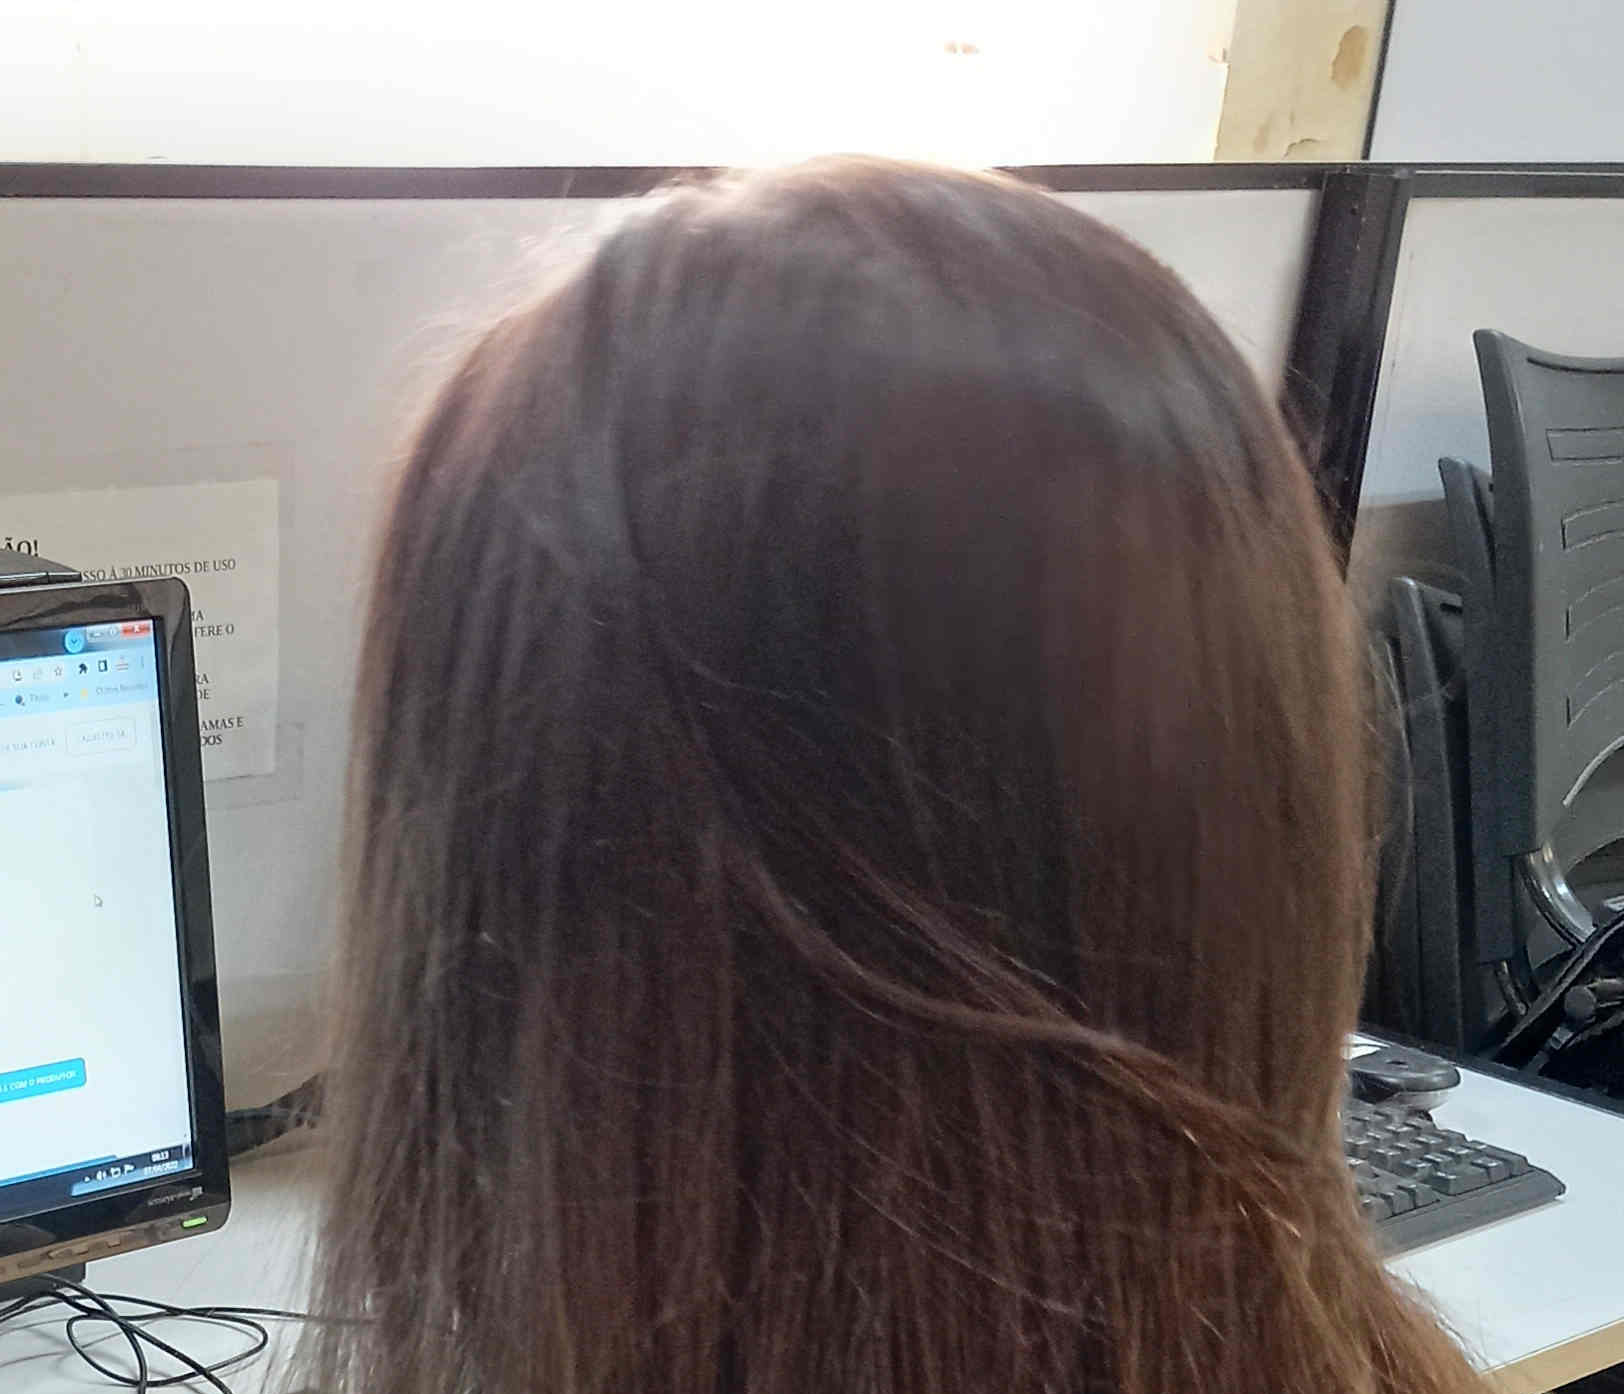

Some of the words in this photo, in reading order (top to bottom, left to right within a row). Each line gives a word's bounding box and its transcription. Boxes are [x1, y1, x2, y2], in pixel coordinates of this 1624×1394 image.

[134, 561, 190, 578] MINUTOS
[194, 561, 210, 574] DE
[213, 558, 236, 572] USO
